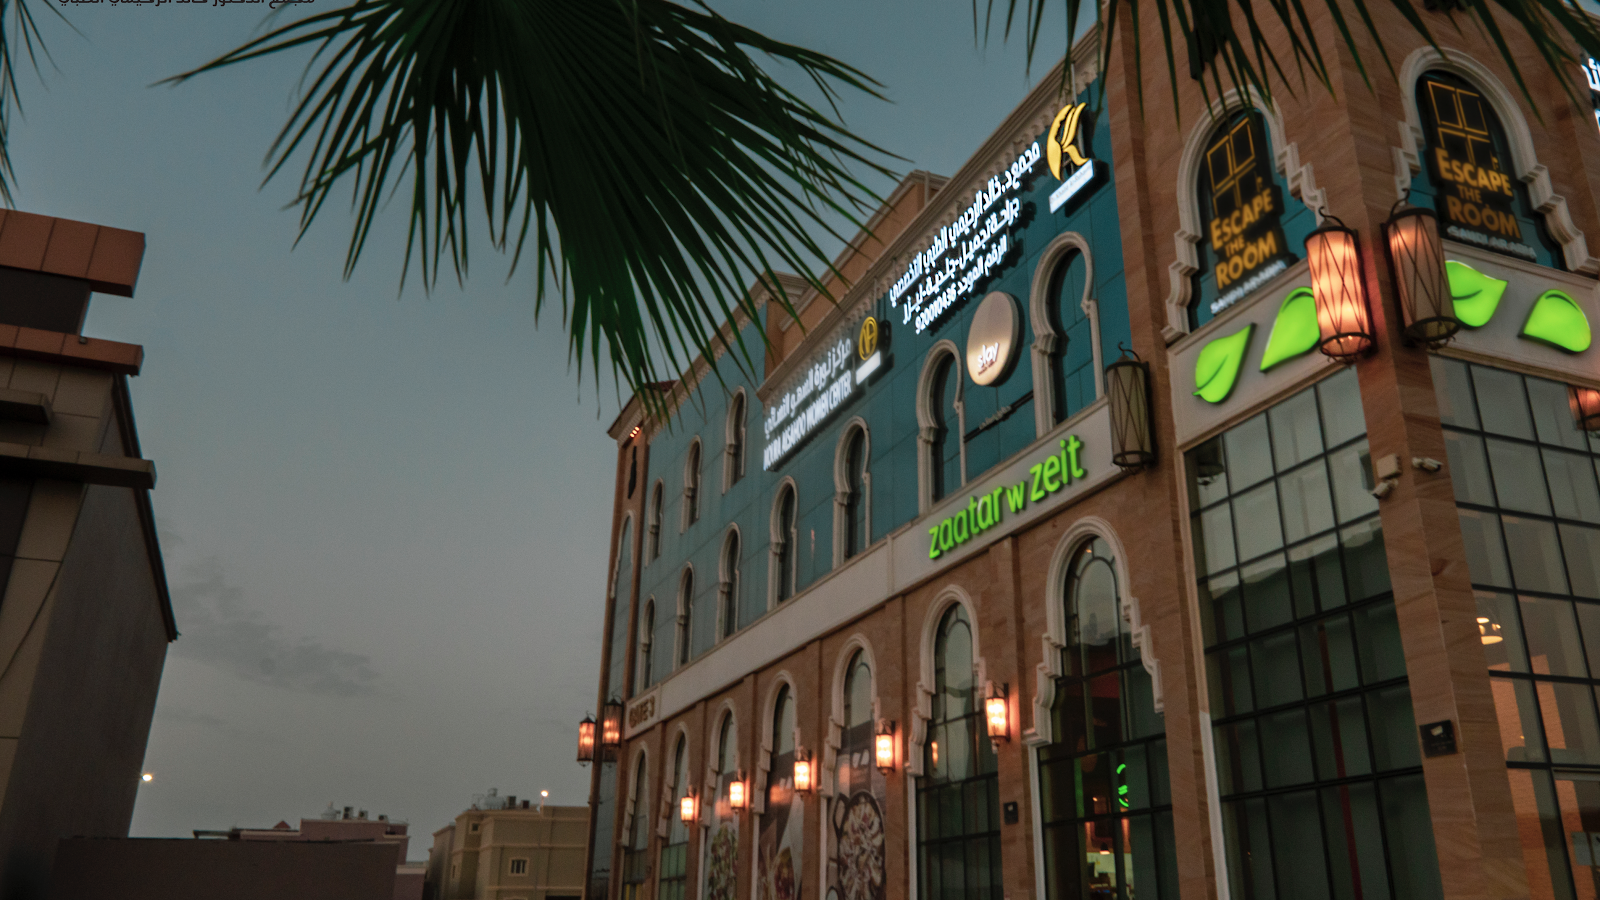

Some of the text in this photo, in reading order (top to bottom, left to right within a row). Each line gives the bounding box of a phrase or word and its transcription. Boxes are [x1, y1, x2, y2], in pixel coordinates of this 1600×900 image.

[1011, 141, 1041, 190] مجمع
[1434, 147, 1513, 197] ESCAPE
[991, 197, 1020, 235] جراحة
[1446, 195, 1520, 239] ROOM
[1457, 184, 1482, 204] THE
[949, 190, 984, 248] الرحيمي
[1210, 188, 1273, 251] ESCAPE
[923, 225, 949, 274] الطبي
[984, 234, 1007, 277] الرقم
[1215, 230, 1277, 289] ROOM
[1225, 234, 1245, 258] THE
[890, 251, 923, 308] التخصصي
[958, 255, 984, 293] الموحد
[831, 337, 852, 379] مركز
[977, 342, 999, 368] slay
[928, 435, 1084, 559] zaatar w zeit
